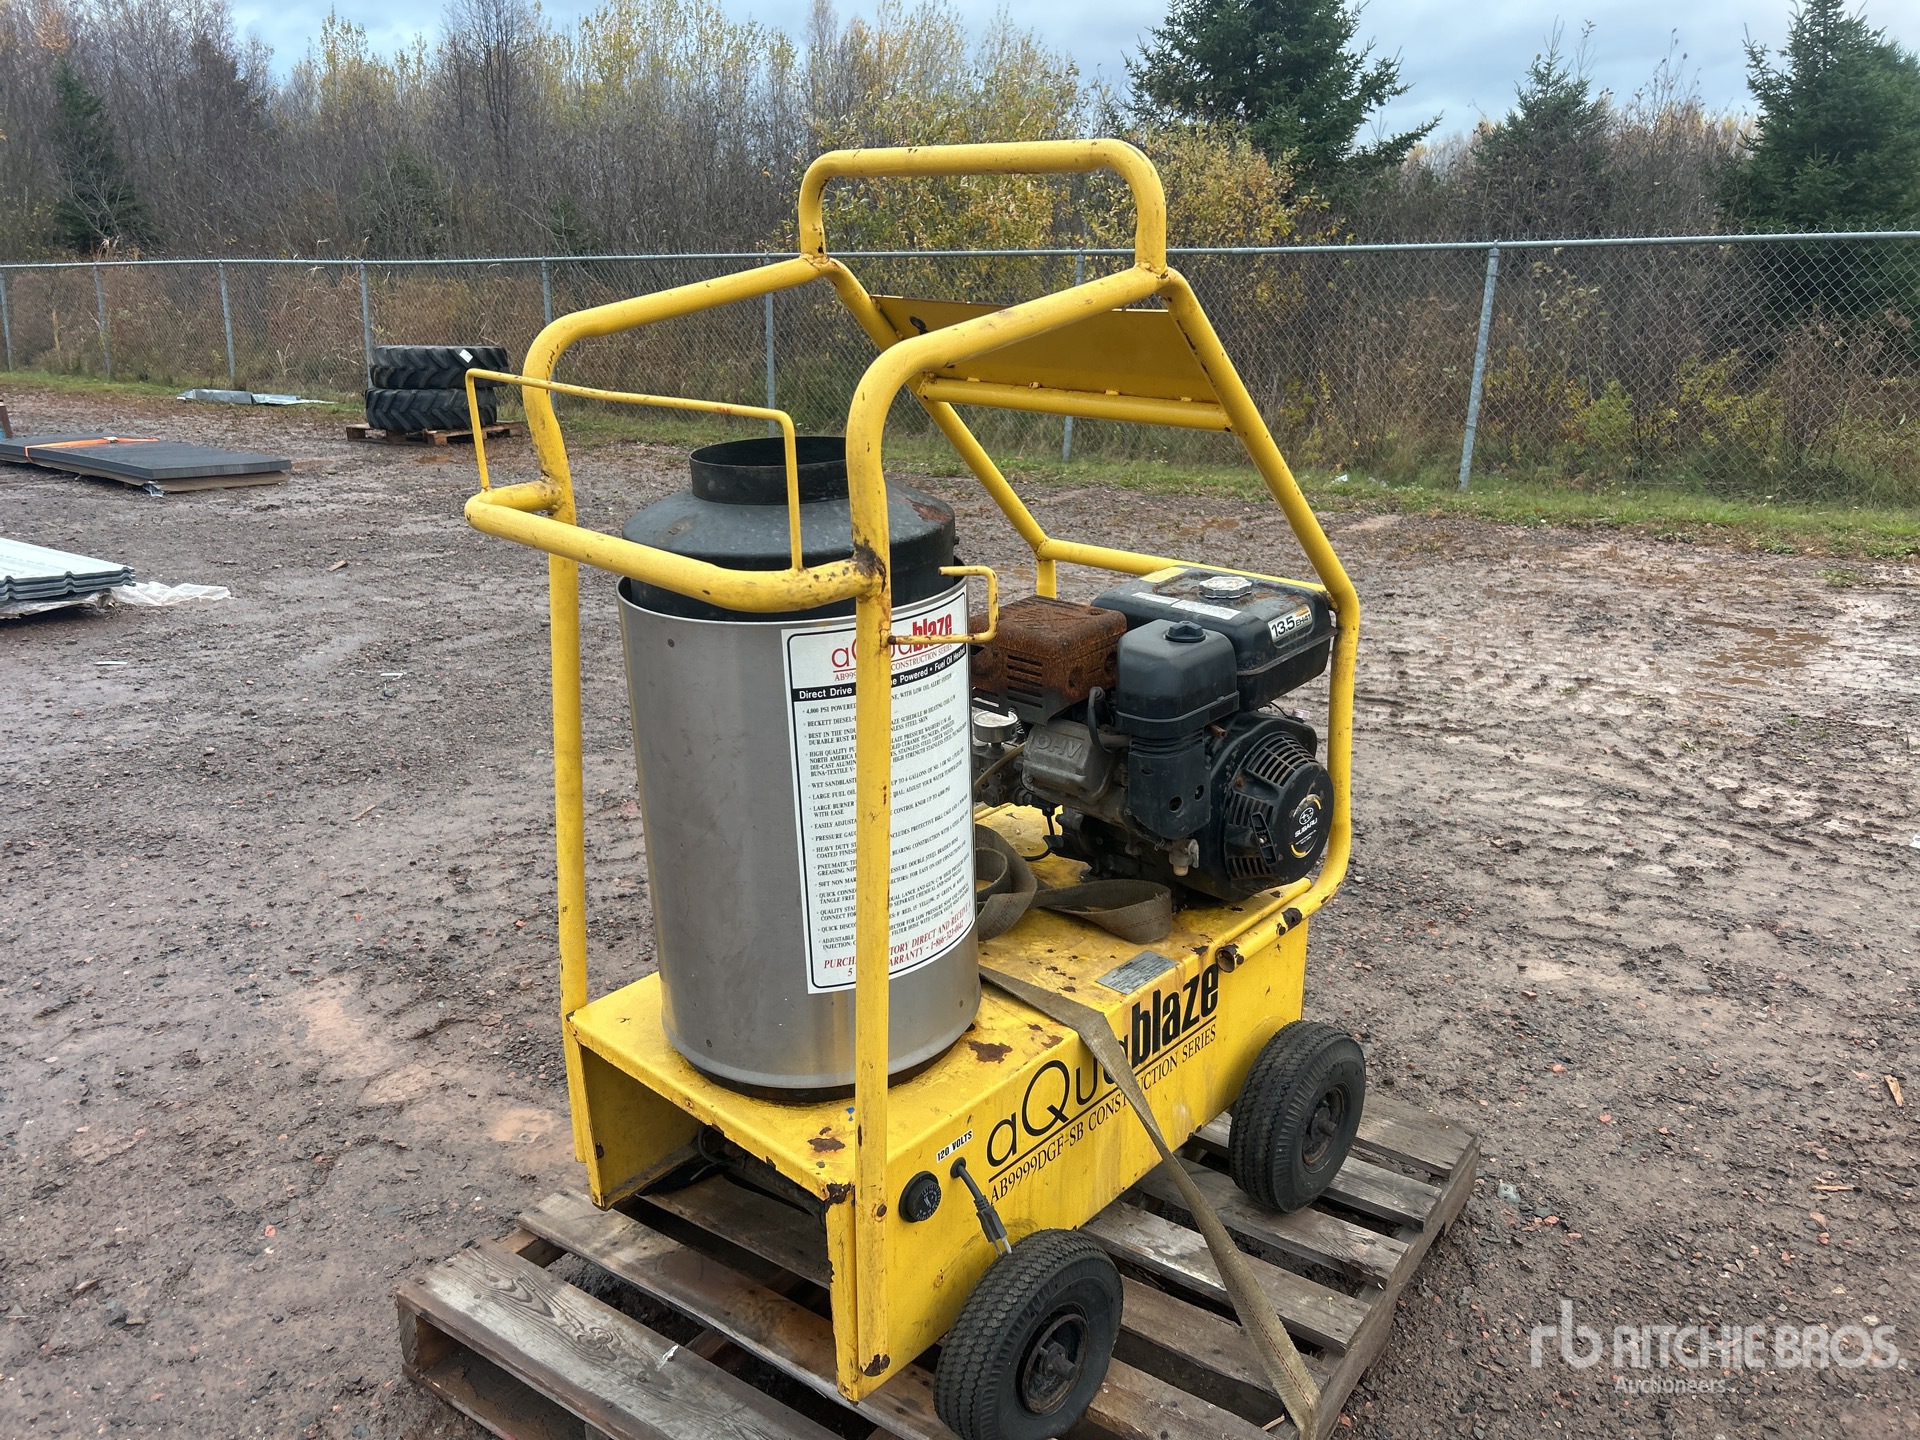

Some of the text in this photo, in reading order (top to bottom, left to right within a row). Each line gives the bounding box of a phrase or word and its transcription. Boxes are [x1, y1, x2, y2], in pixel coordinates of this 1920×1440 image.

[1272, 616, 1295, 637] 13.5
[800, 689, 826, 700] Direct
[830, 687, 852, 696] Drive
[900, 667, 928, 684] Powered
[934, 656, 945, 672] Fuel
[946, 649, 954, 665] Oil
[808, 719, 831, 727] BECKETT
[809, 738, 834, 746] DURABLE
[1032, 733, 1082, 758] OHV
[825, 748, 847, 756] QUALITY
[830, 754, 854, 762] AMERICA
[836, 760, 856, 768] ALUMIN
[832, 790, 846, 798] FUEL
[833, 801, 854, 810] BURNER
[1295, 818, 1318, 838] SUBARU
[816, 833, 842, 841] PRESSURE
[890, 828, 910, 838] NCLUDES
[818, 860, 848, 870] PNEUMATIC
[891, 864, 908, 874] ESSURE
[818, 868, 844, 876] GREASING
[820, 896, 840, 904] TANGLE
[820, 908, 843, 916] QUALITY
[820, 913, 846, 922] CONNECT
[823, 934, 854, 944] ADJUSTABLE
[824, 956, 856, 968] PURCH
[890, 942, 909, 956] TORY
[912, 929, 936, 948] DIRECT
[939, 920, 950, 934] AND
[848, 968, 852, 976] 5
[889, 947, 923, 967] ARRANTY
[1088, 1052, 1179, 1131] CONSTCTION
[1182, 1024, 1216, 1063] SERIES
[938, 1130, 972, 1161] 120 VOLTS
